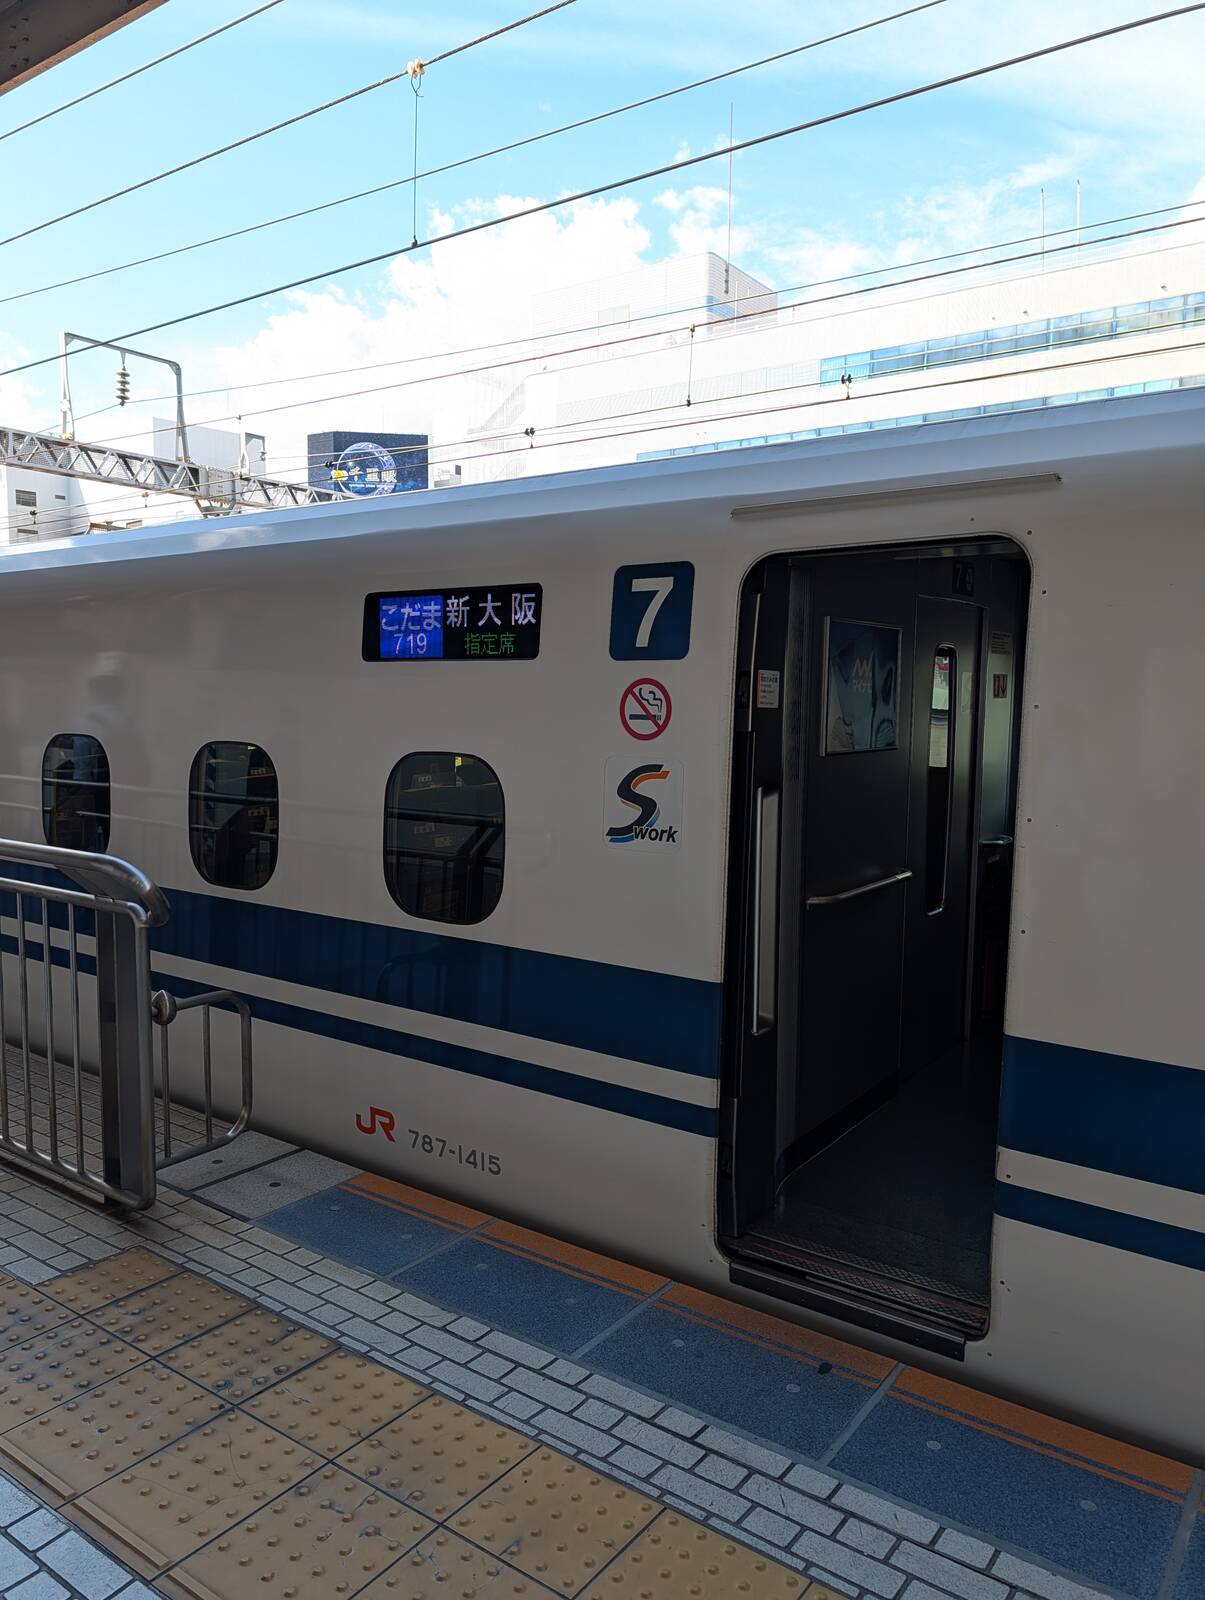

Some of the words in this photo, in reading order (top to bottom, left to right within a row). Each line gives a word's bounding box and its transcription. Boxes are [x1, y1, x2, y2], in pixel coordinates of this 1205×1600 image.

[381, 601, 443, 631] こだま
[446, 592, 537, 628] 新大阪
[631, 576, 674, 648] 7
[393, 632, 427, 655] 719
[464, 631, 517, 655] 指定席
[633, 825, 679, 843] work
[355, 1106, 395, 1143] JR
[408, 1129, 501, 1175] 787-1415
